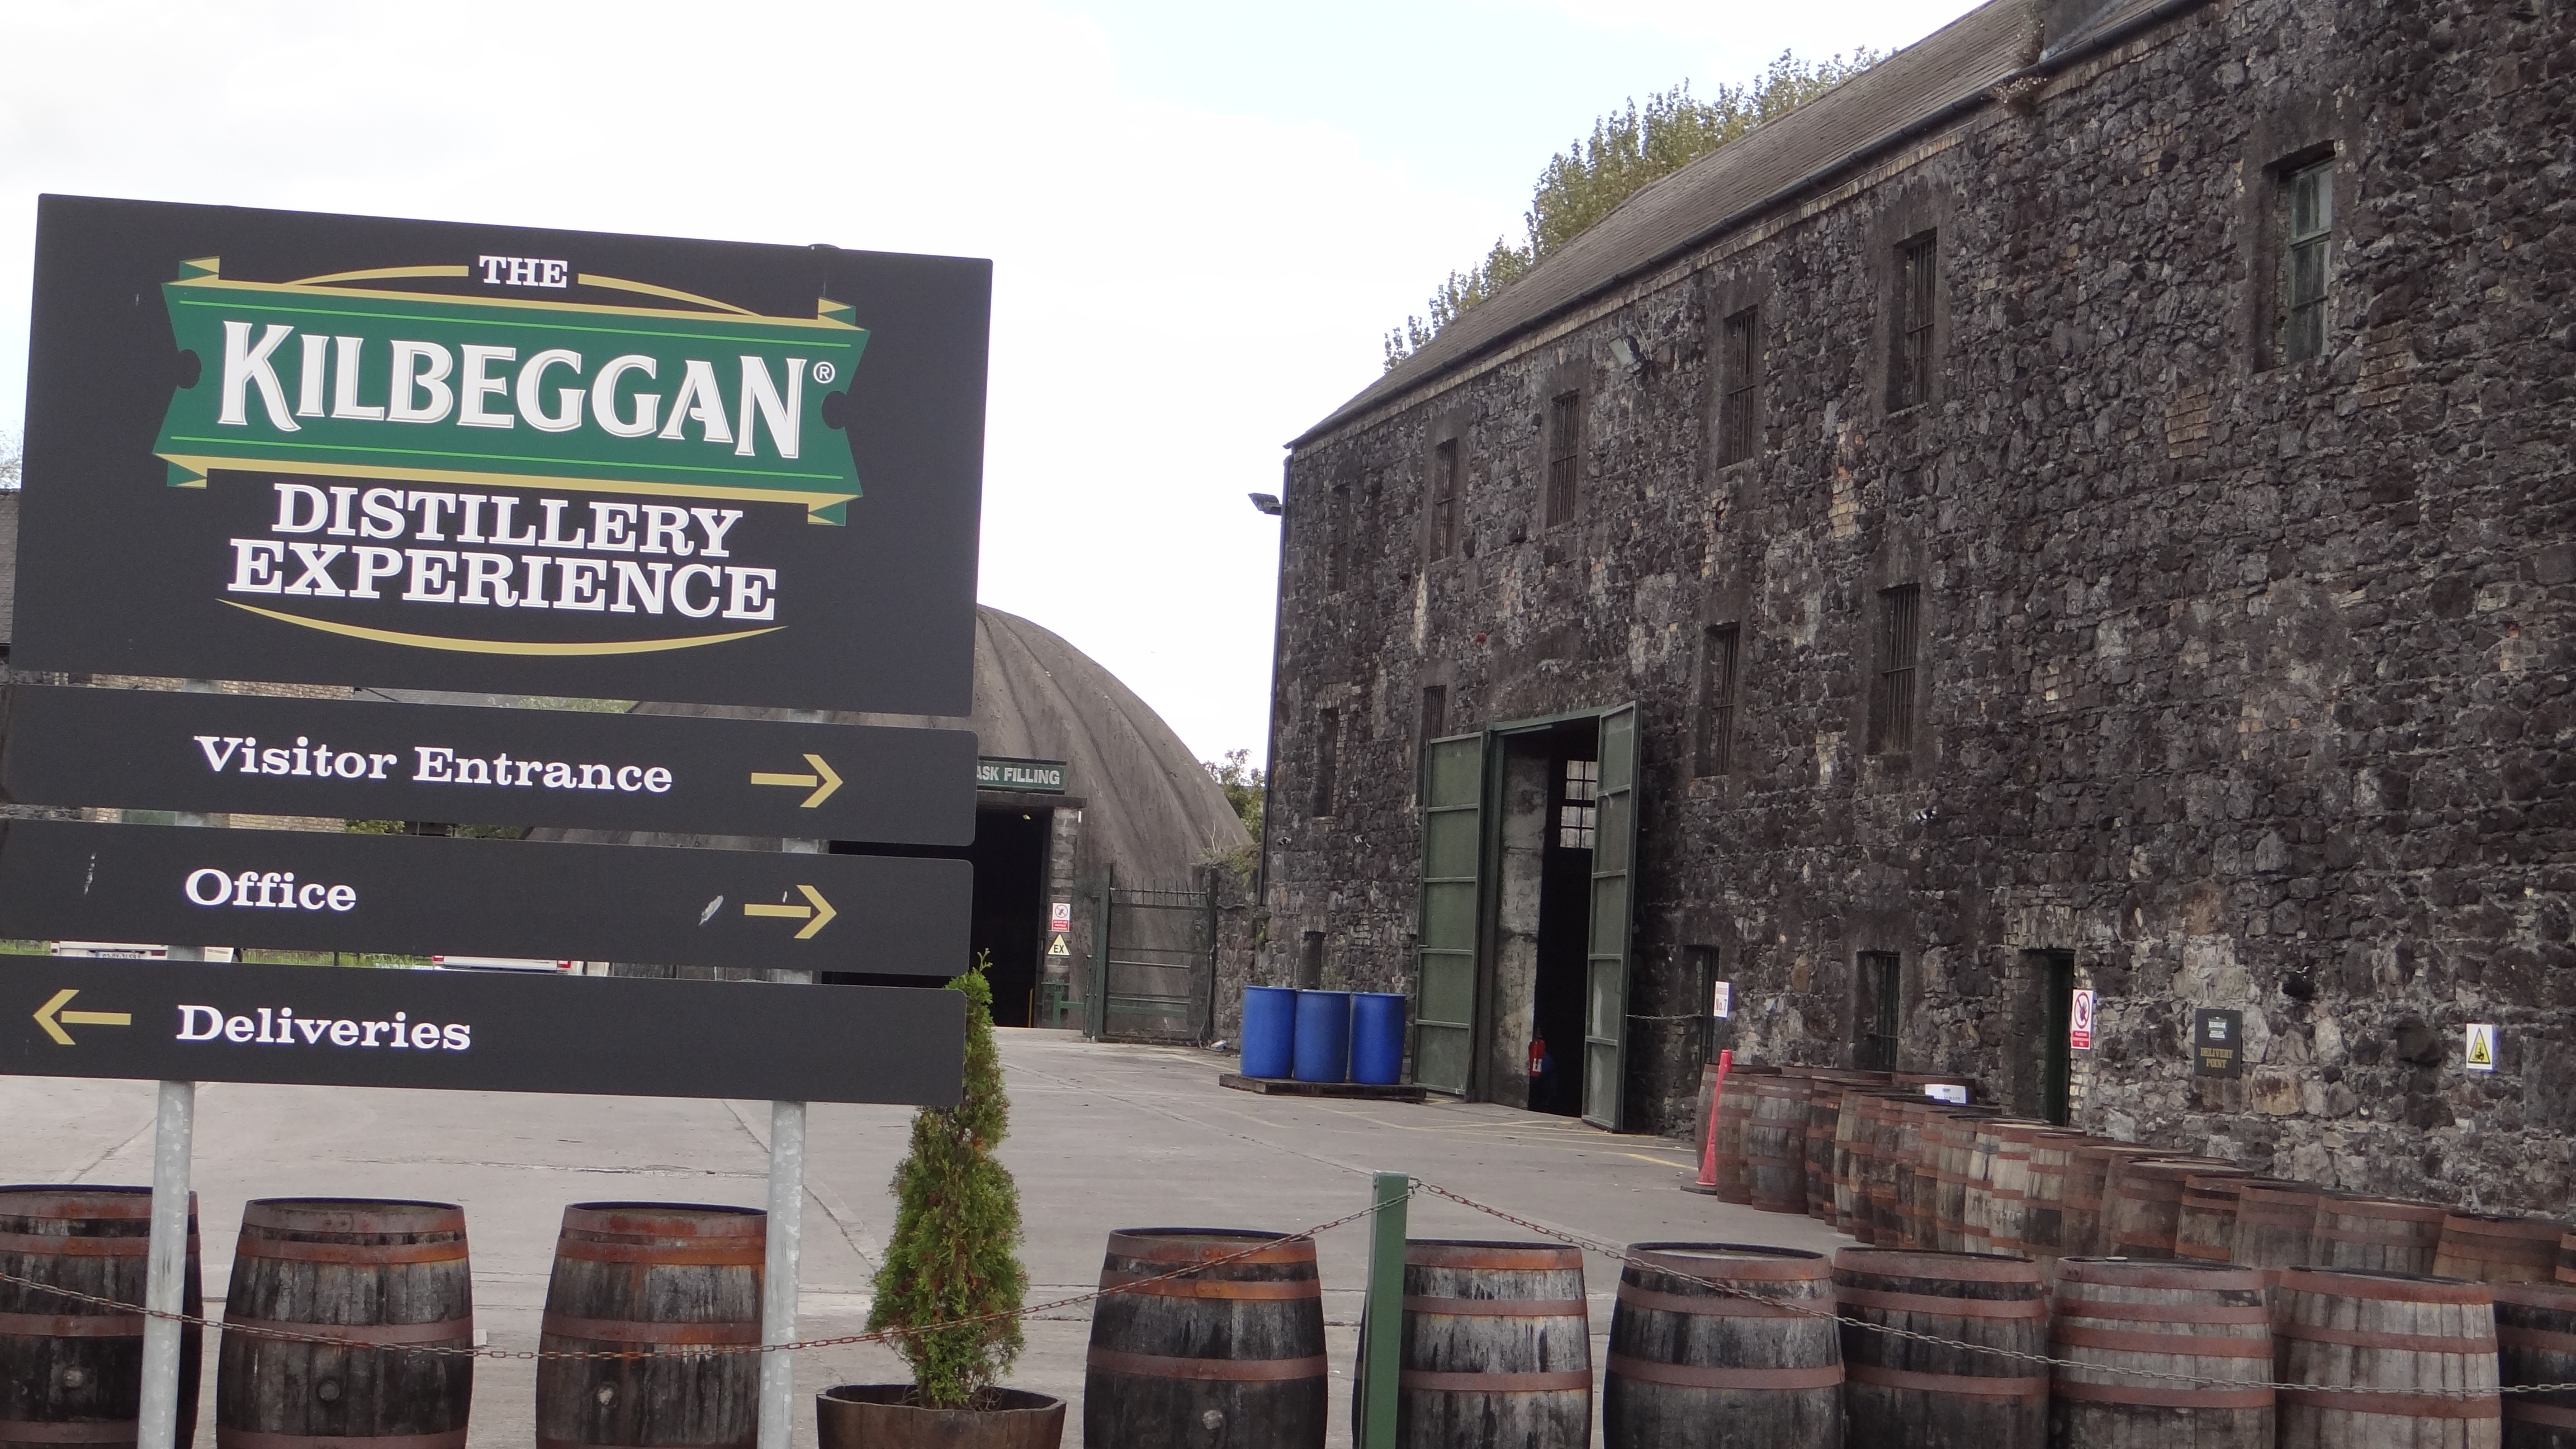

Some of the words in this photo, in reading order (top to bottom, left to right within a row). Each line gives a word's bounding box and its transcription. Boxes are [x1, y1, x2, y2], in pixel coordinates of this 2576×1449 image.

[479, 254, 569, 289] THE
[216, 320, 808, 460] KILBEGGAN
[272, 483, 744, 558] DISTILLERY
[226, 538, 777, 622] EXPERIENCE
[193, 736, 397, 779] Visitor
[413, 746, 673, 793] Entrance
[1004, 767, 1060, 784] FILLING
[186, 868, 357, 911] Office
[1054, 945, 1064, 954] EX
[1724, 998, 1727, 1011] 7
[176, 1005, 471, 1050] Deliveries
[2200, 1047, 2233, 1058] DELIVERY
[2206, 1058, 2227, 1068] POINT
